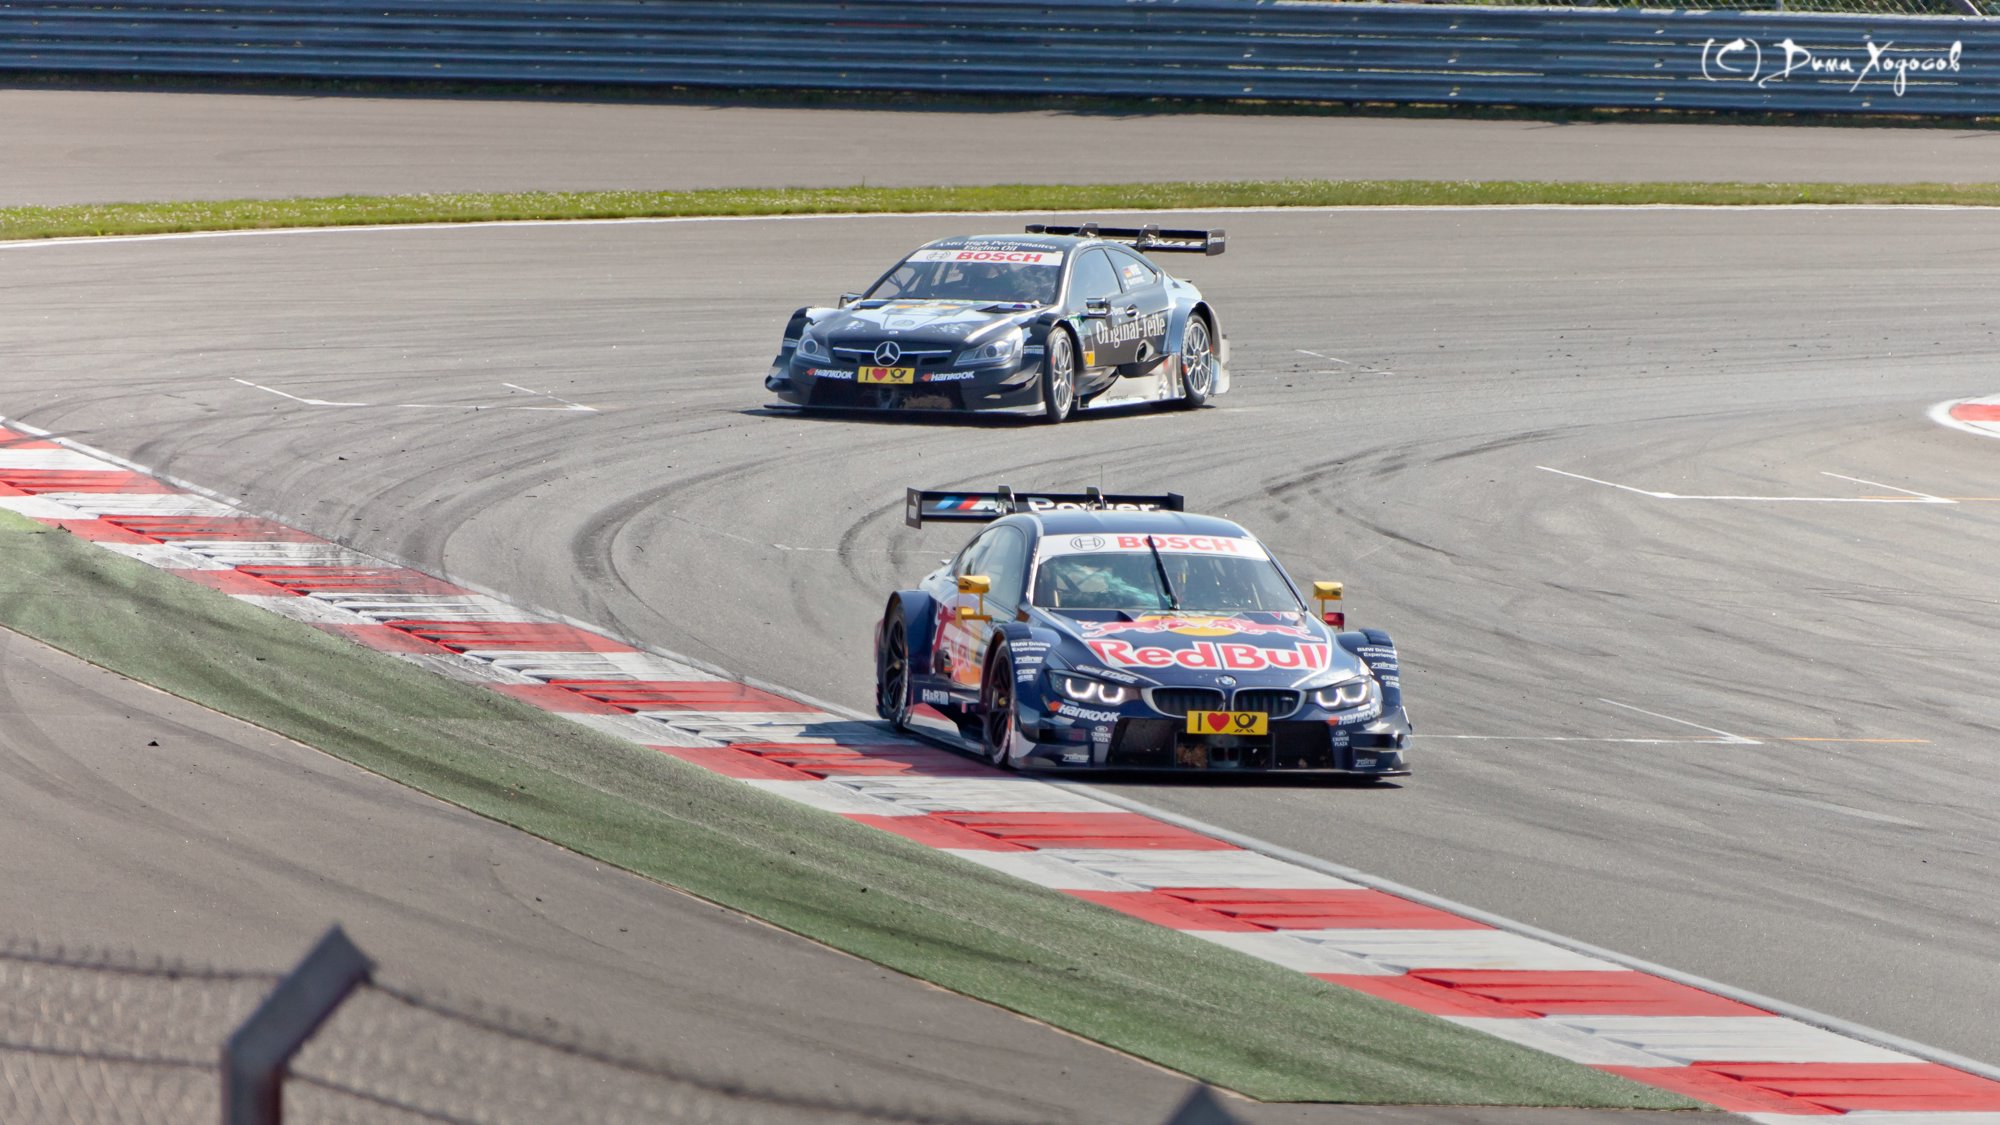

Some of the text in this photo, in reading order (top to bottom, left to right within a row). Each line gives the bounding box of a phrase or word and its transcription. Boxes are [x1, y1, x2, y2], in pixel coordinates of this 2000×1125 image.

[956, 252, 1042, 263] BOSCH
[1116, 536, 1238, 552] BOSCH
[1101, 670, 1138, 684] EDGE
